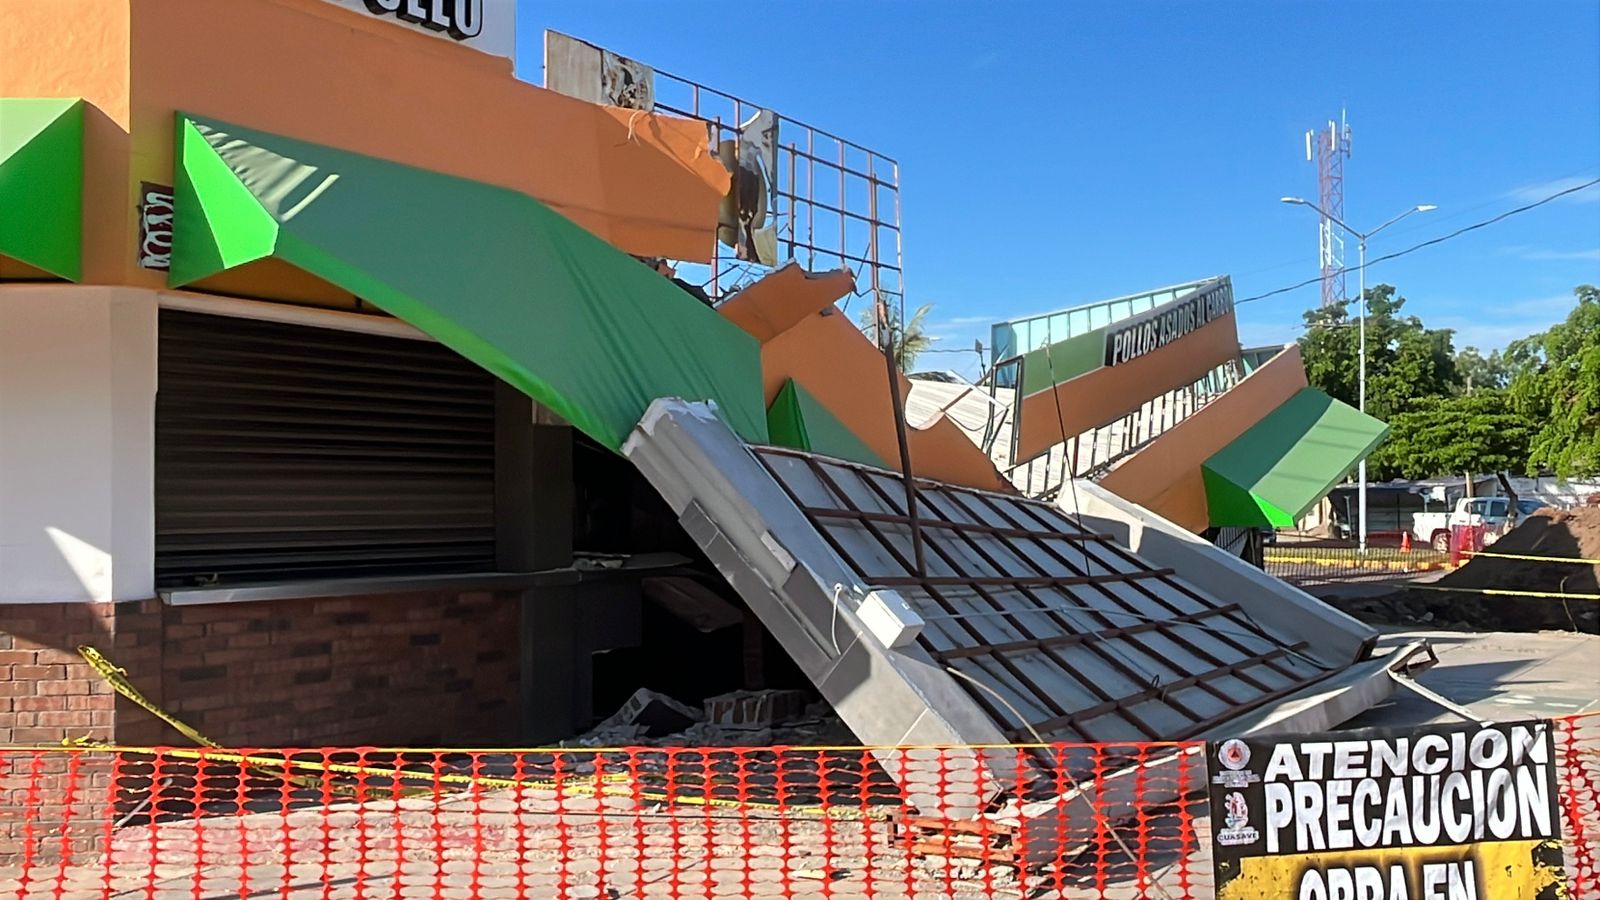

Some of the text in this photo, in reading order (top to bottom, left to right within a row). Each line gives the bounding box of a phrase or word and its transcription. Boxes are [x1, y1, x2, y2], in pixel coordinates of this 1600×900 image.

[1112, 320, 1158, 367] POLLOS
[1159, 302, 1195, 347] ASADOS
[1196, 295, 1206, 328] AL
[1264, 764, 1552, 853] PRECAUCION
